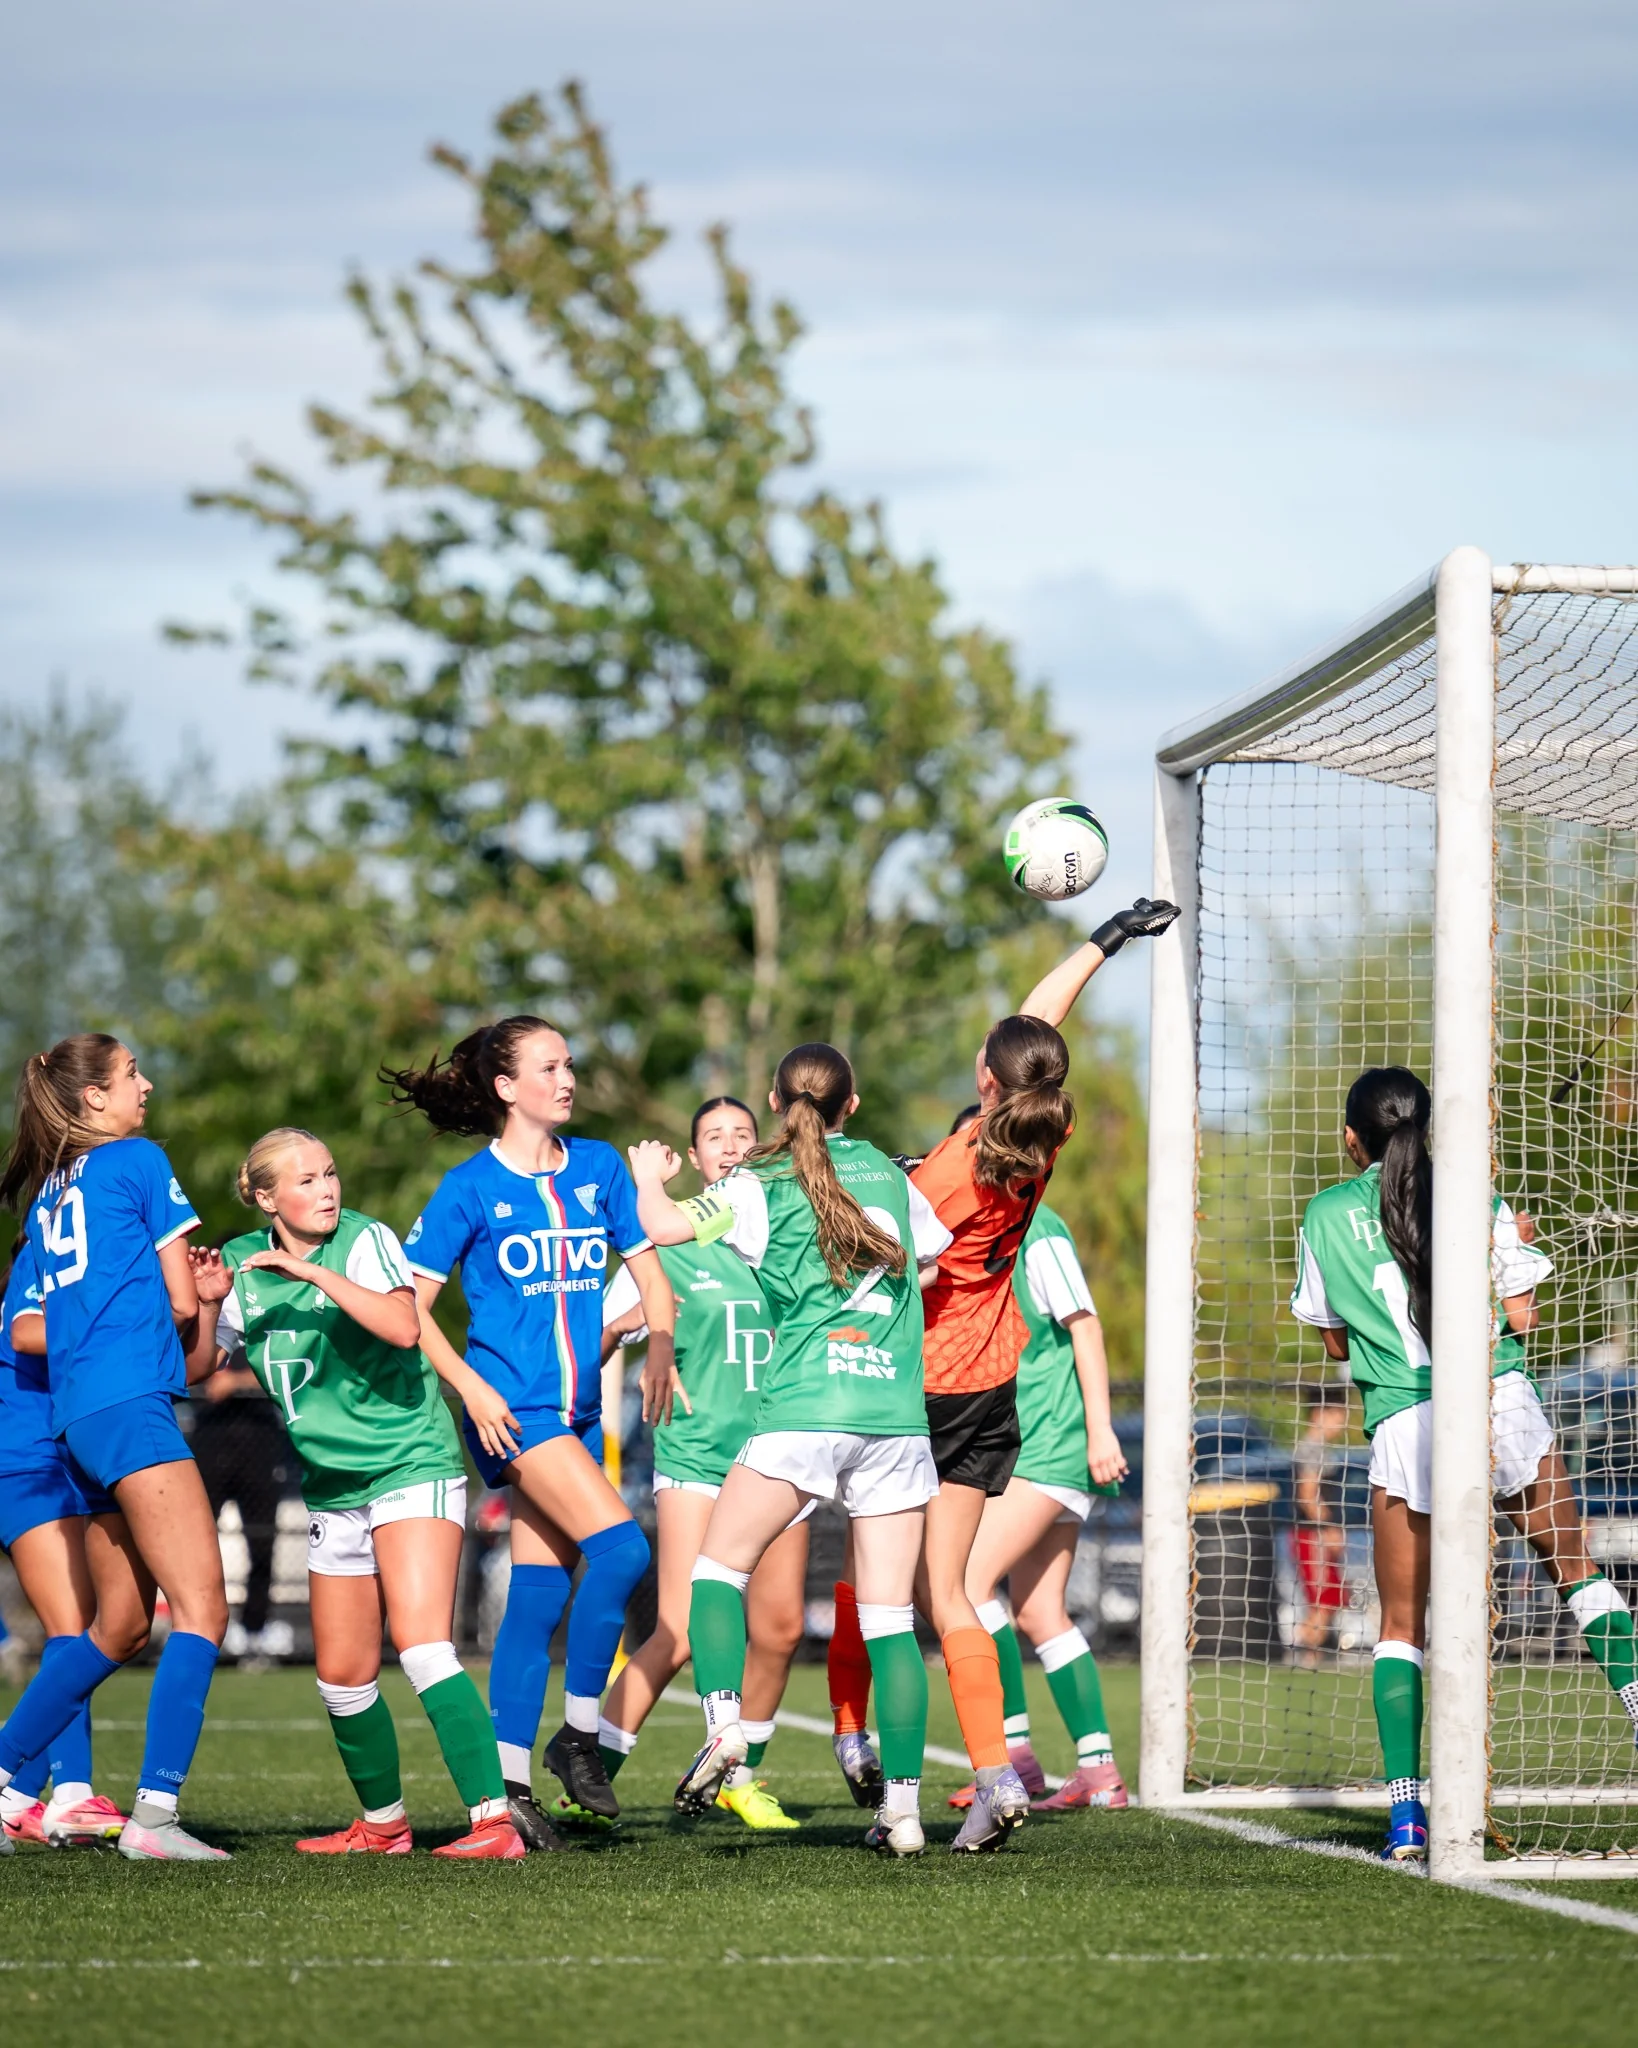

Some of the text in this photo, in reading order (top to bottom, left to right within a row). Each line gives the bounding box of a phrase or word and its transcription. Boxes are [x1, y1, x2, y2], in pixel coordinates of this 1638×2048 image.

[1064, 852, 1077, 896] acron
[839, 1172, 884, 1184] PARTNERS
[1347, 1207, 1383, 1252] FP
[37, 1186, 88, 1298] 19
[522, 1278, 600, 1297] DEVELOPMENTS
[246, 1305, 266, 1316] eills
[722, 1300, 774, 1392] FP
[828, 1342, 893, 1365] NEXT
[263, 1329, 314, 1425] FP
[828, 1358, 897, 1379] PLAY
[376, 1492, 405, 1505] oneills
